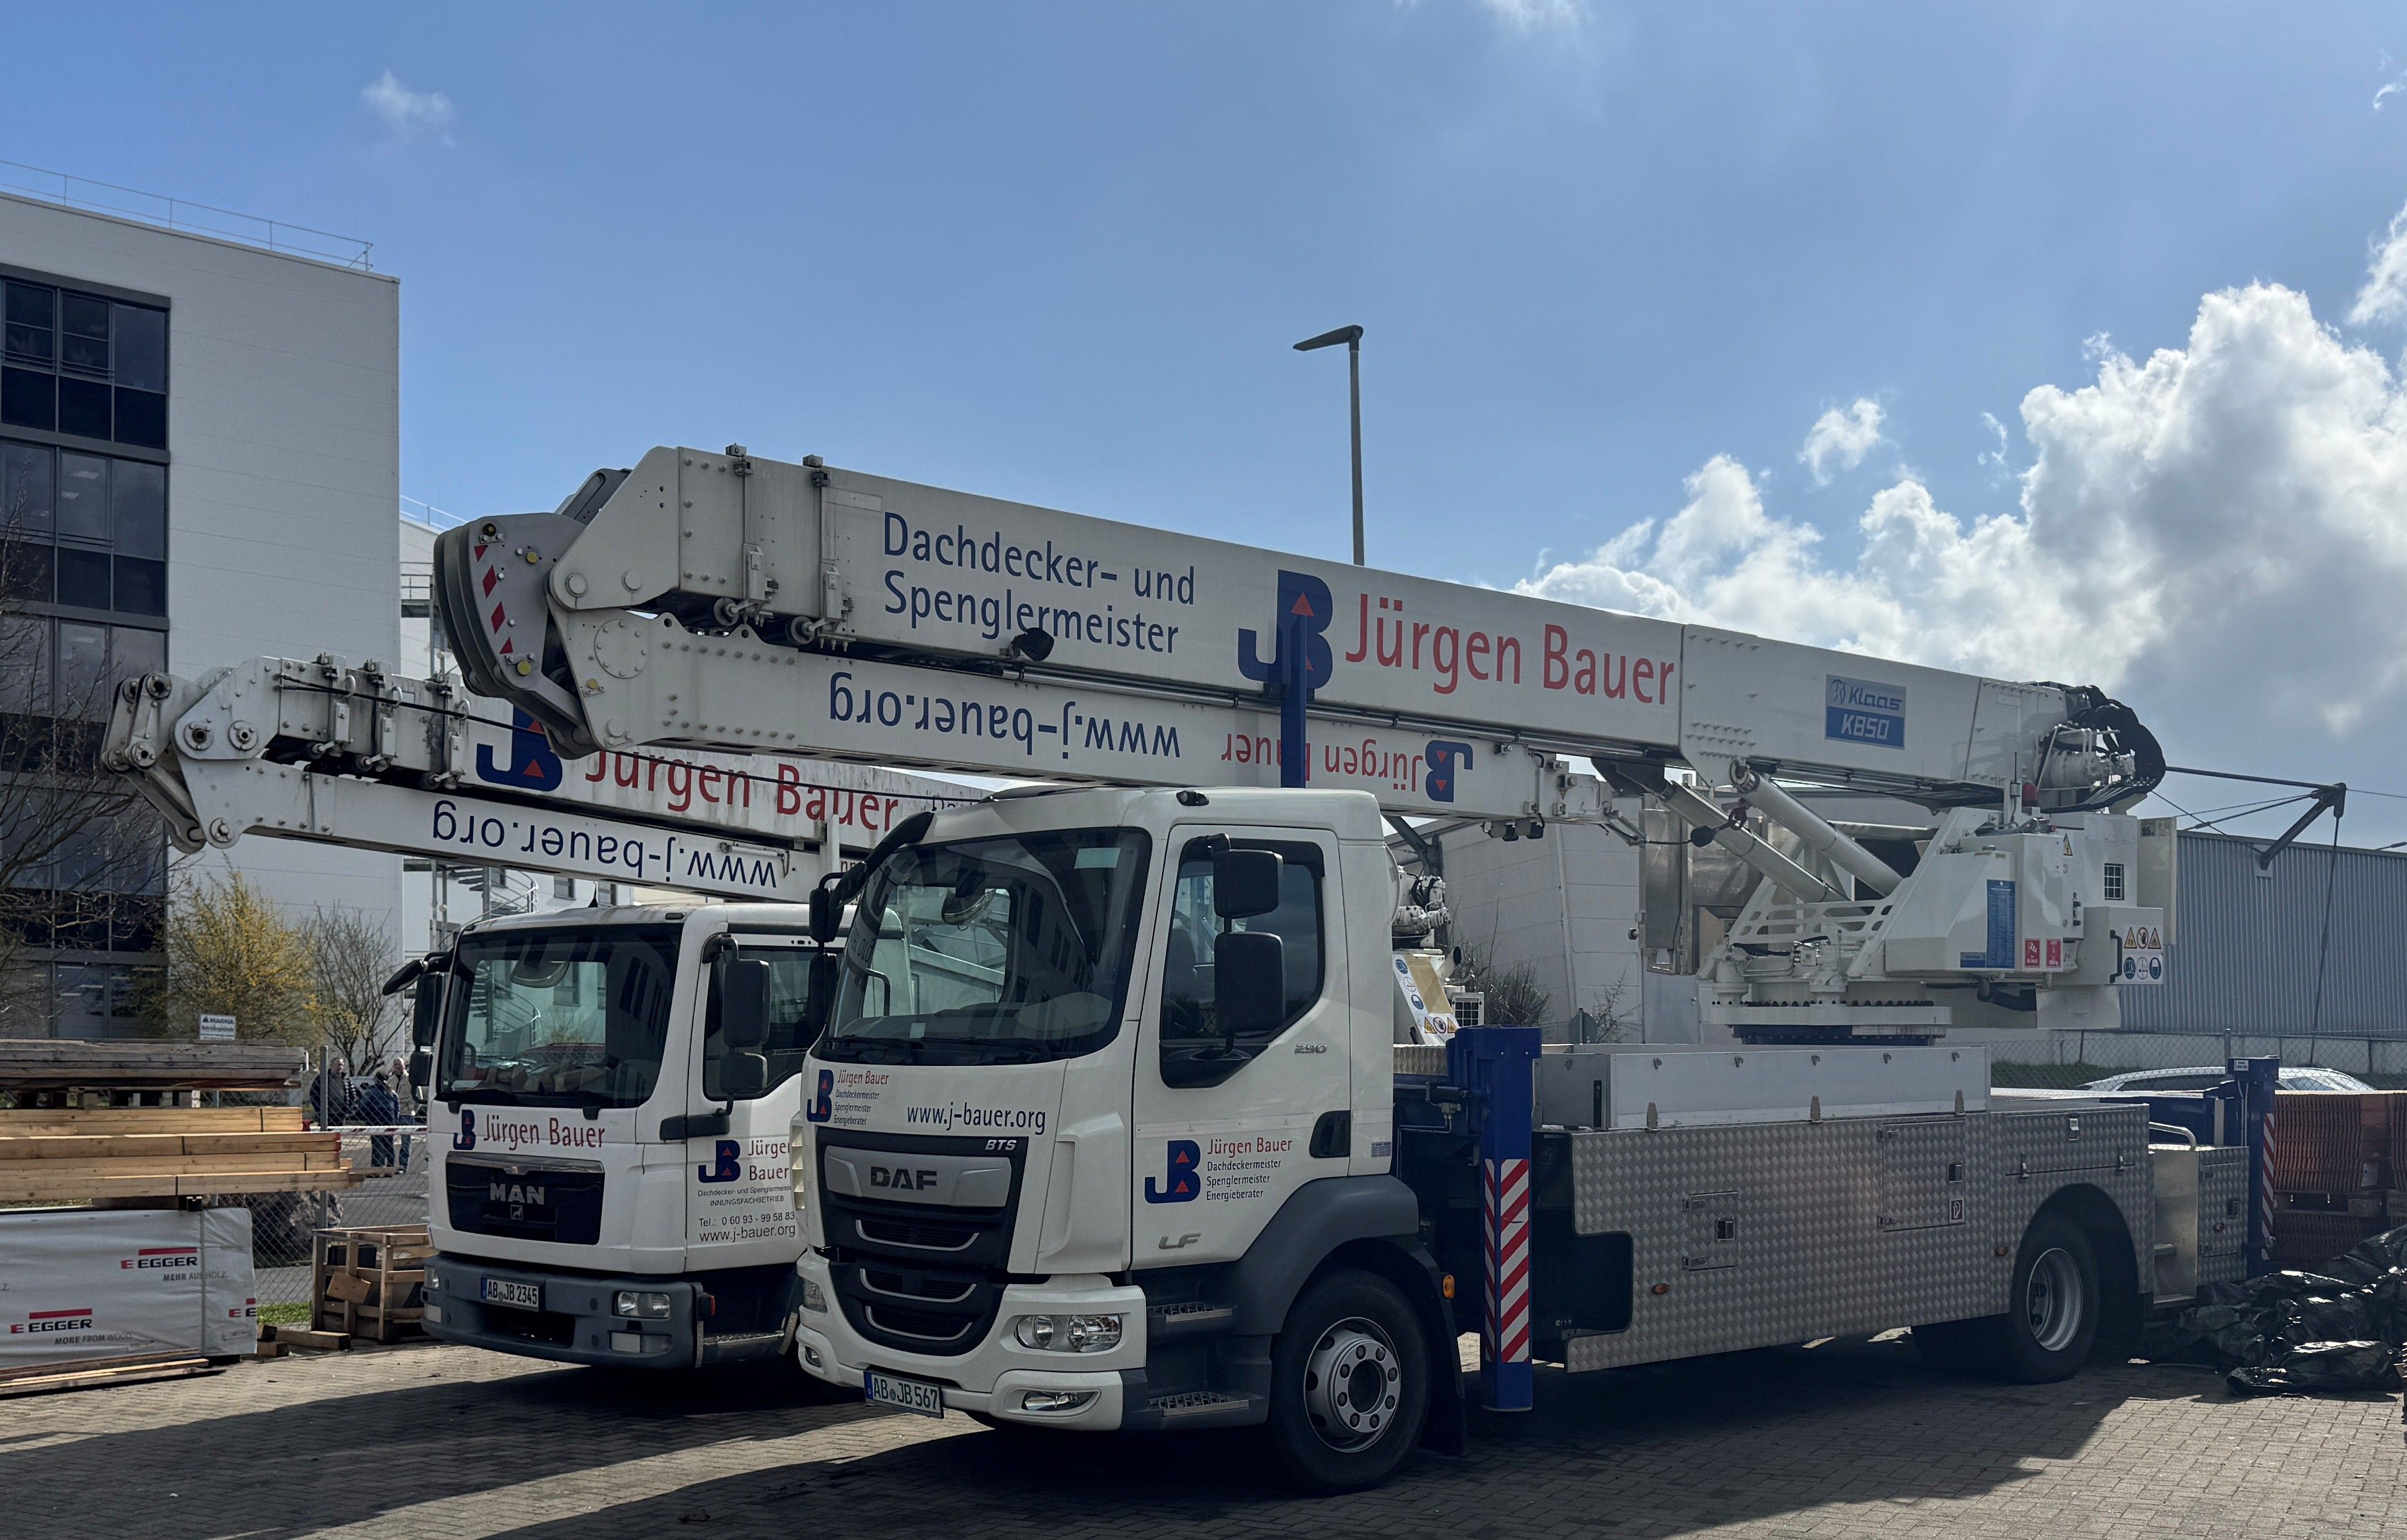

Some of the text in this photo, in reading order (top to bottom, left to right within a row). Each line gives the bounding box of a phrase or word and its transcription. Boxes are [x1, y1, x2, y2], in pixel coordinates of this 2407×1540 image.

[884, 512, 1194, 605] Dachdecker- und
[885, 570, 1179, 653] Spenglermeister
[1345, 593, 1675, 705] Jürgen Bauer
[1849, 686, 1902, 711] Klaas
[829, 671, 1181, 759] www.j-bauer.org
[1841, 713, 1890, 740] K850
[1221, 733, 1423, 792] Jürgen uer
[776, 763, 899, 832] Bauer
[433, 800, 777, 888] www.j-bauer.org
[837, 1069, 889, 1087] Jürgen Bauer
[908, 1101, 1046, 1135] www.j-bauer.org
[484, 1114, 605, 1151] Jürgen Bauer
[985, 1139, 1018, 1151] BTS
[1207, 1137, 1293, 1158] Jürgen Bauer
[749, 1165, 789, 1181] Bauer
[1207, 1158, 1281, 1171] Dachdeckermeister
[871, 1166, 937, 1190] DAF
[1207, 1174, 1270, 1188] Spenglermeister
[489, 1183, 545, 1205] MAN
[1206, 1189, 1264, 1202] Energieberater
[722, 1217, 727, 1226] 0
[730, 1216, 740, 1224] 60
[742, 1215, 753, 1224] 93
[761, 1214, 771, 1223] 99
[773, 1213, 783, 1221] 58
[785, 1212, 795, 1220] 83
[700, 1225, 796, 1243] www.j-bauer.org
[1158, 1233, 1201, 1250] LF
[138, 1257, 197, 1268] EGGER
[163, 1273, 186, 1282] MEHR
[488, 1281, 537, 1305] AB JB 2345
[29, 1319, 93, 1333] EGGER
[54, 1336, 80, 1345] MORE
[874, 1377, 938, 1410] AB JB 567
